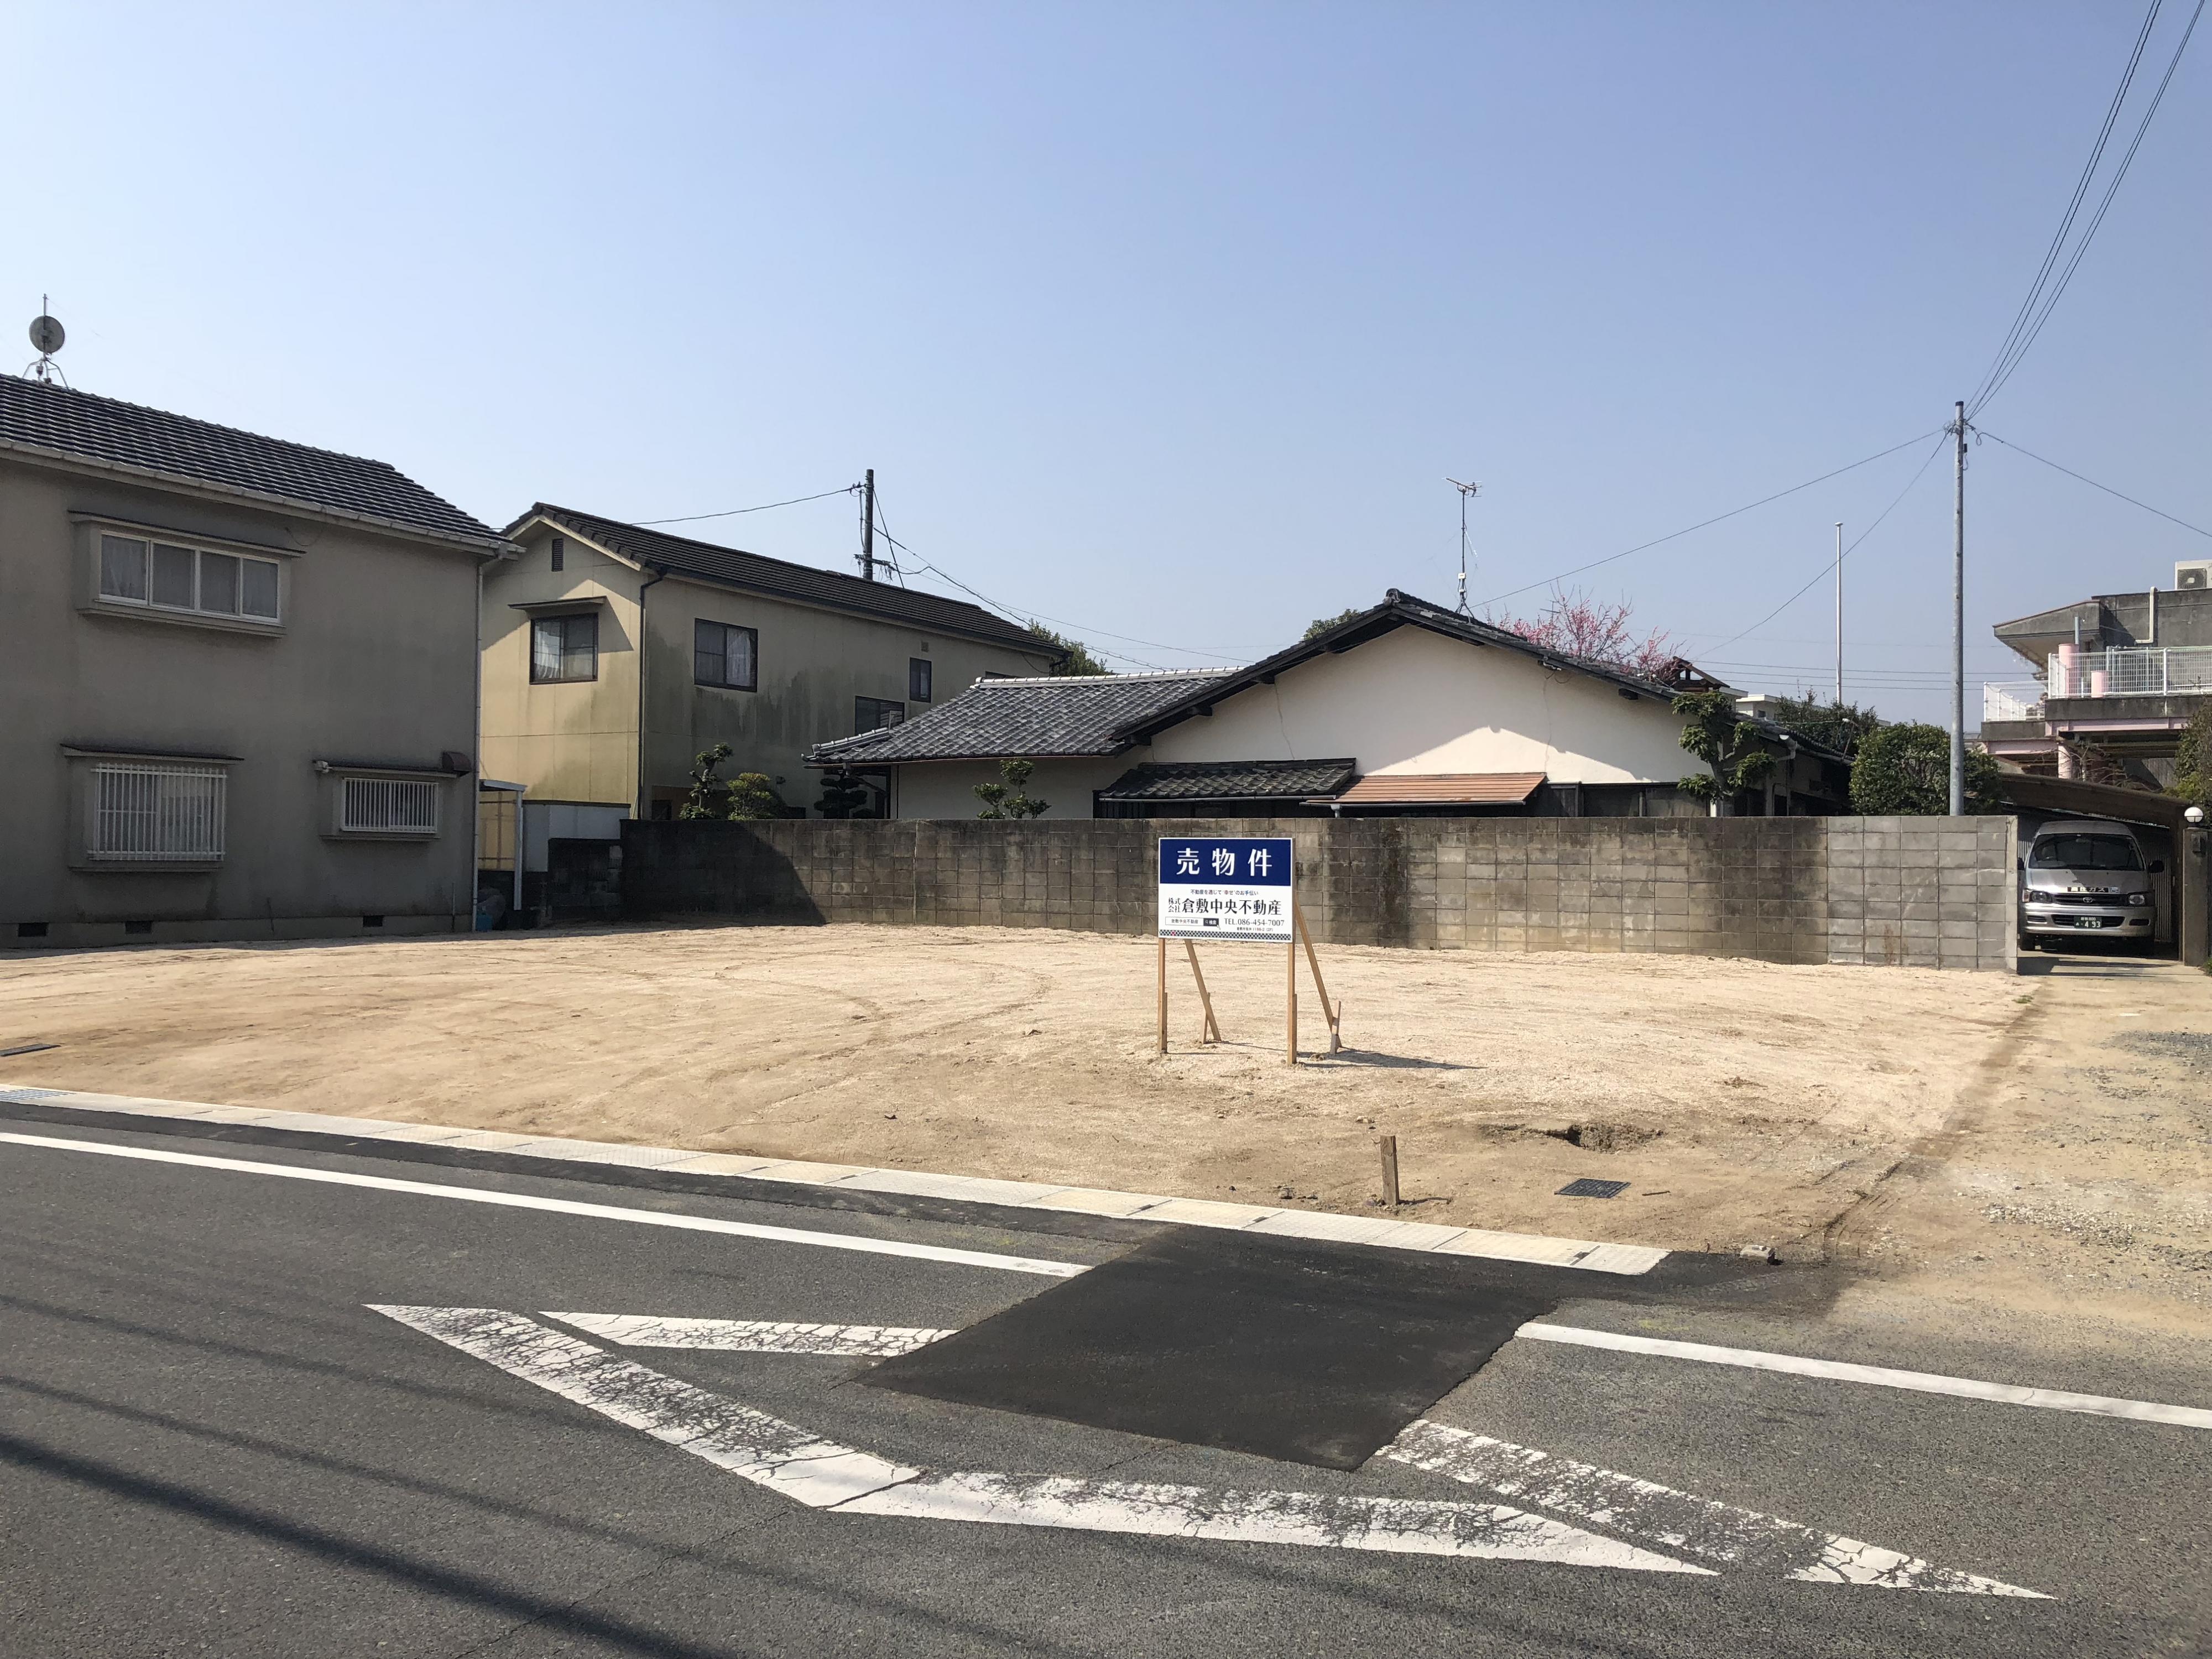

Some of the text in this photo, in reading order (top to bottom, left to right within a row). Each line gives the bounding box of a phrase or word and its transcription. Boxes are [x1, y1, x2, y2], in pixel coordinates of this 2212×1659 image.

[1176, 848, 1272, 877] 売物件
[1182, 898, 1282, 915] 倉敷中央不動産
